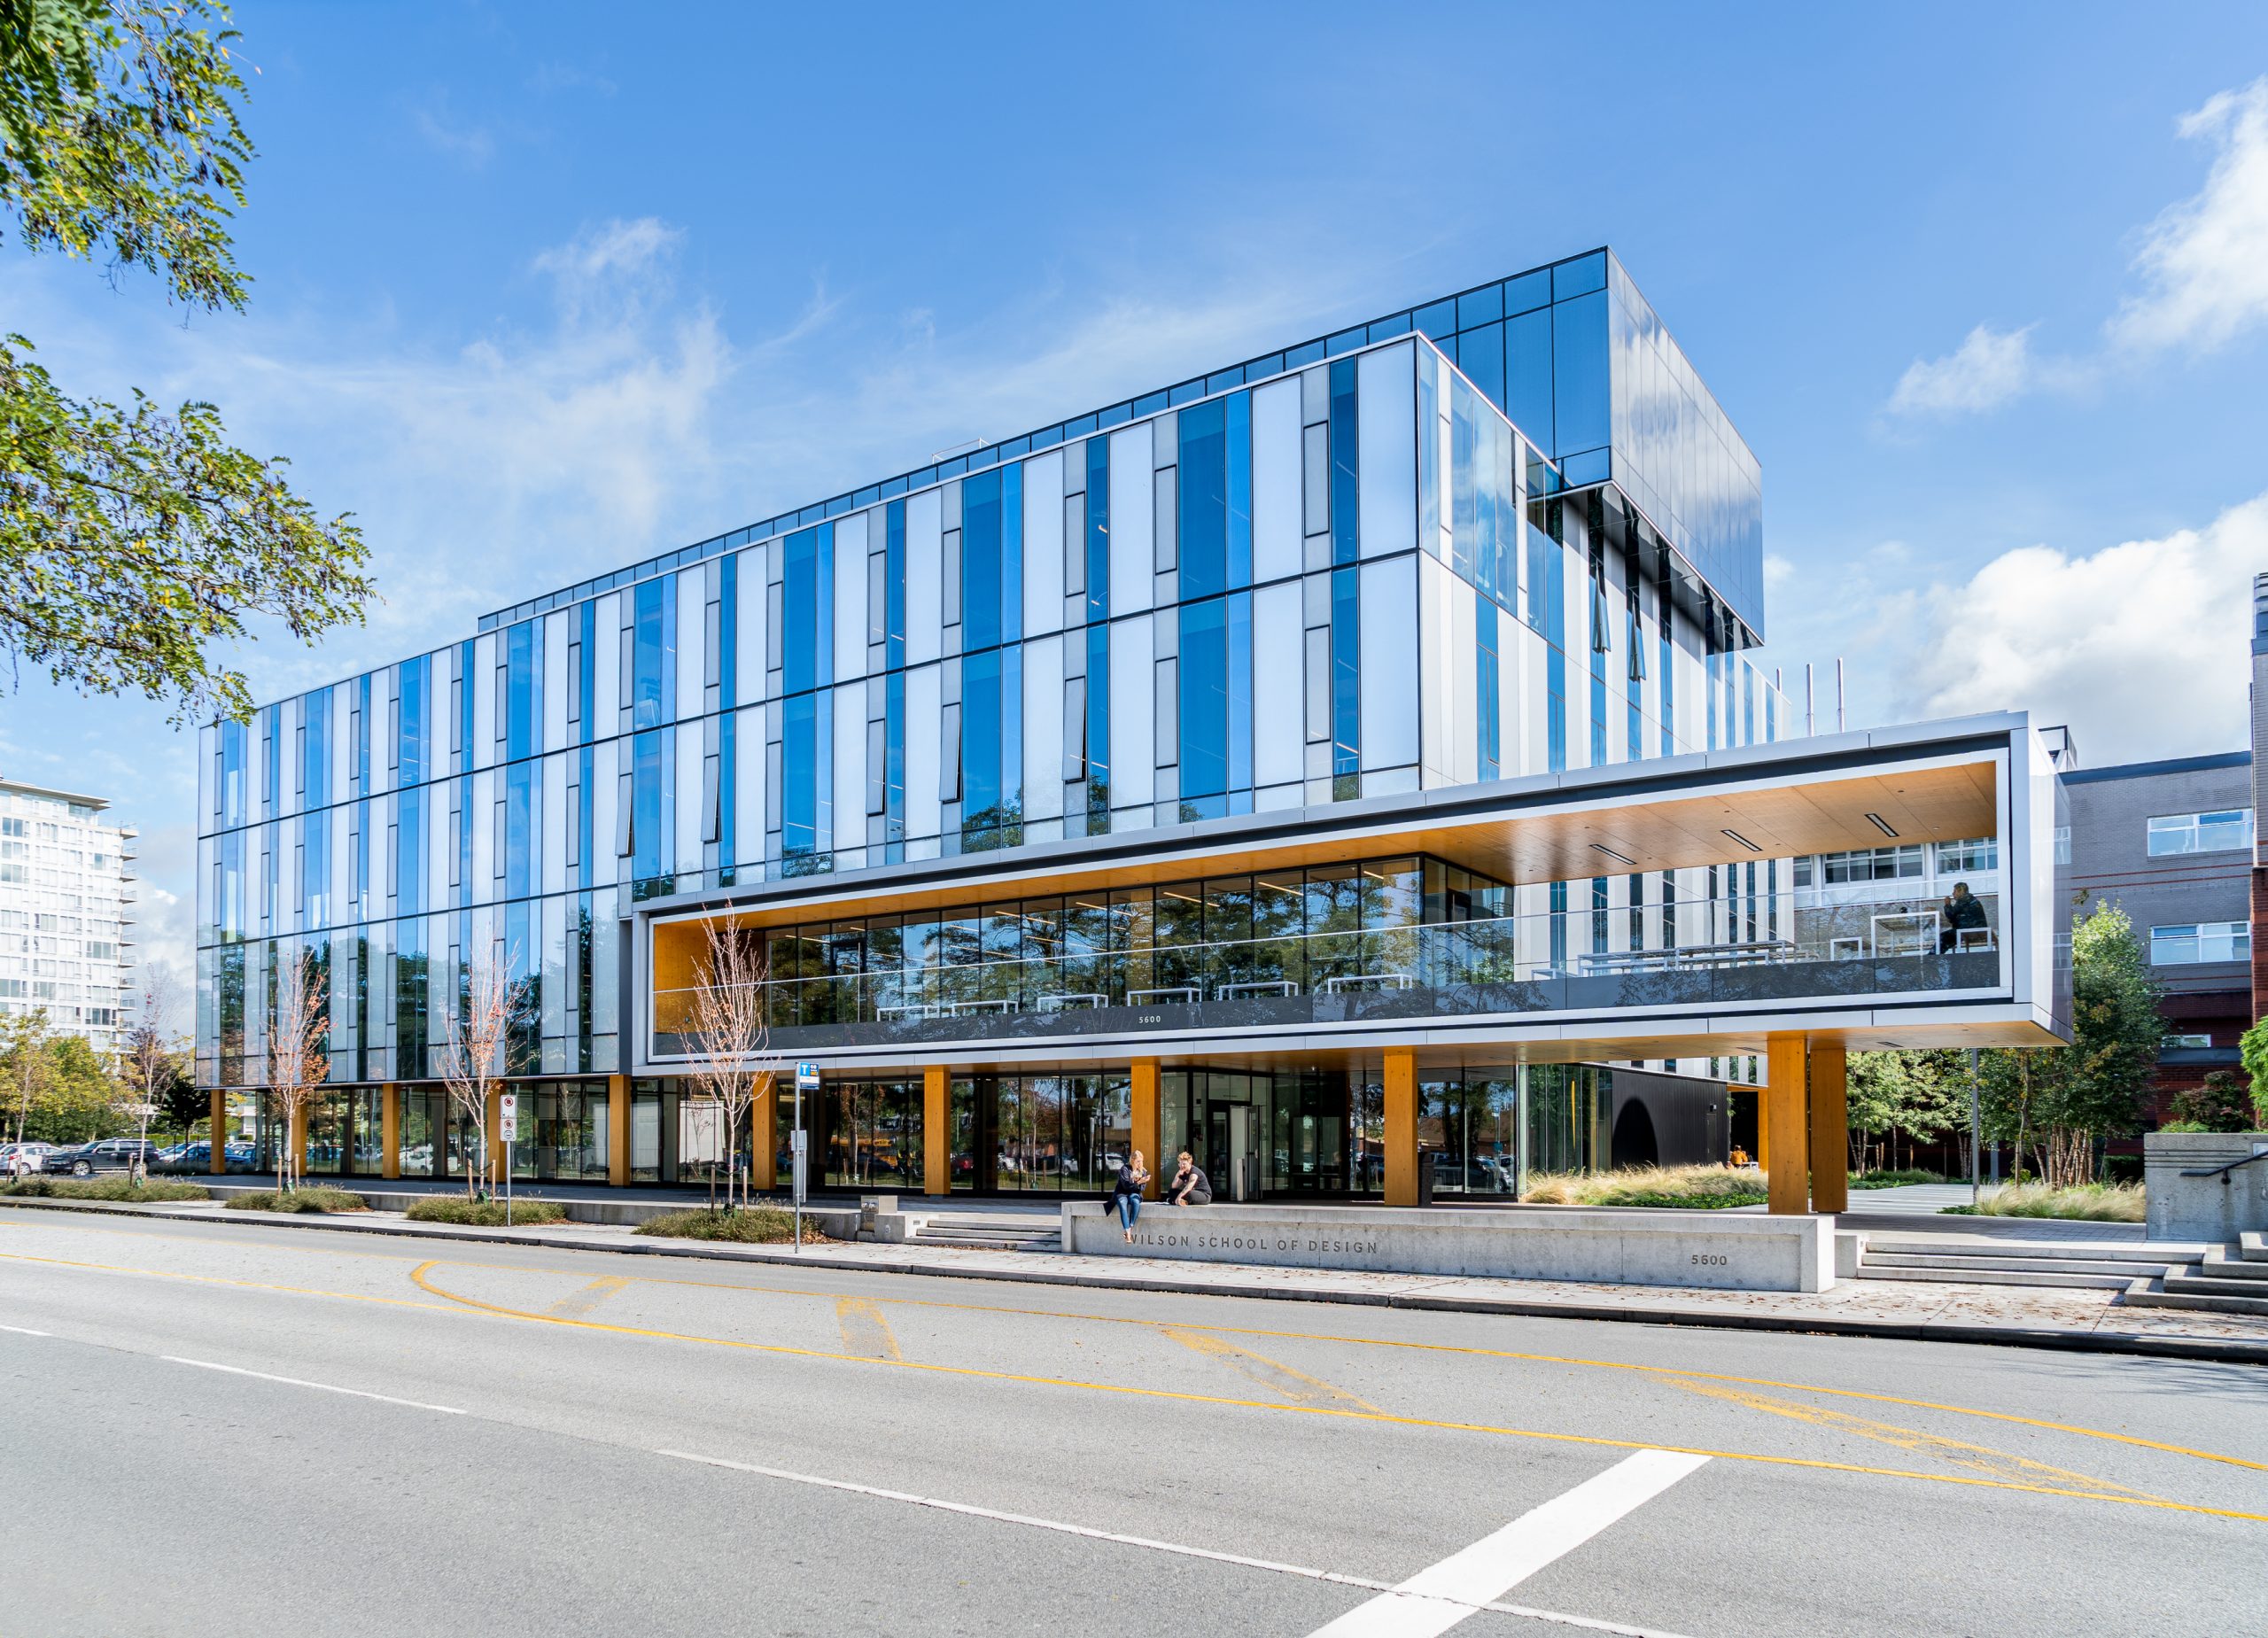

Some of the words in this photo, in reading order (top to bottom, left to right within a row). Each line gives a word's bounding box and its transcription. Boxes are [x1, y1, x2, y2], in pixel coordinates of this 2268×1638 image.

[1138, 1015, 1161, 1024] 5600
[1199, 1237, 1268, 1250] SCHOOL
[1277, 1240, 1299, 1251] OF
[1309, 1240, 1378, 1254] DESIGN
[1691, 1254, 1728, 1266] 5600
